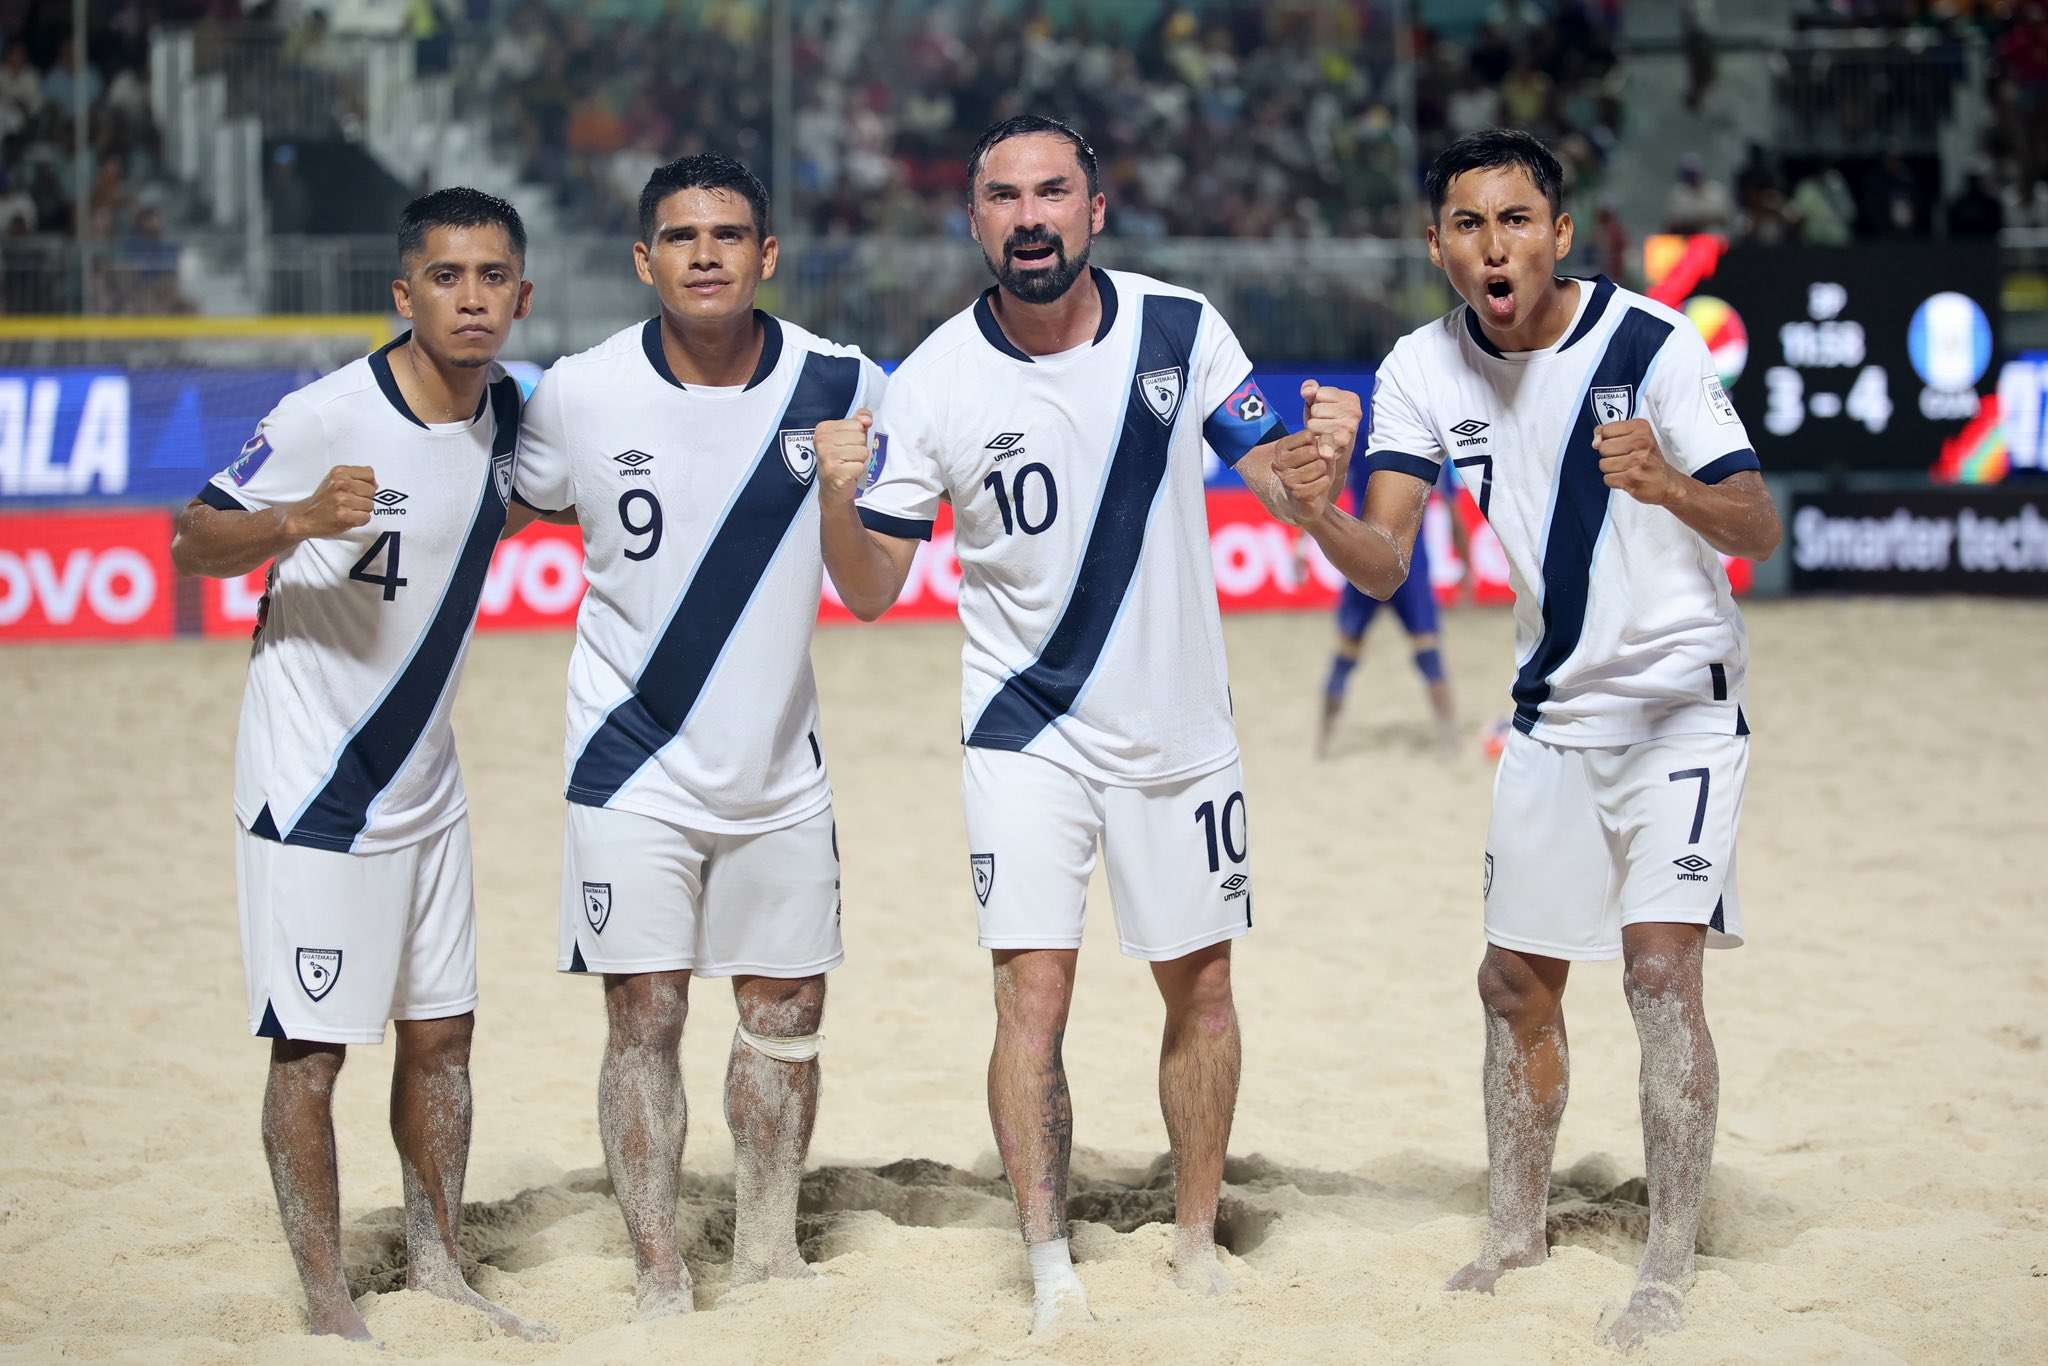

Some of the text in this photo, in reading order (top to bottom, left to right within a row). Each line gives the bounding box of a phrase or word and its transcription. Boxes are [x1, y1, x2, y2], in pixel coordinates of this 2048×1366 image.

[1764, 366, 1805, 436] 3
[1846, 365, 1894, 434] 4
[619, 467, 651, 477] umbro
[994, 446, 1026, 462] umbro
[1456, 436, 1488, 447] umbro
[373, 506, 407, 516] umbro
[983, 462, 1058, 536] 10
[1453, 455, 1493, 523] 7
[618, 488, 663, 562] 9
[1793, 505, 1953, 571] Smarter
[349, 531, 408, 601] 4
[1194, 790, 1247, 873] 10
[1668, 767, 1710, 844] 7
[1223, 889, 1247, 902] umbro
[1677, 872, 1708, 882] umbro
[302, 953, 337, 961] GUATEMALA
